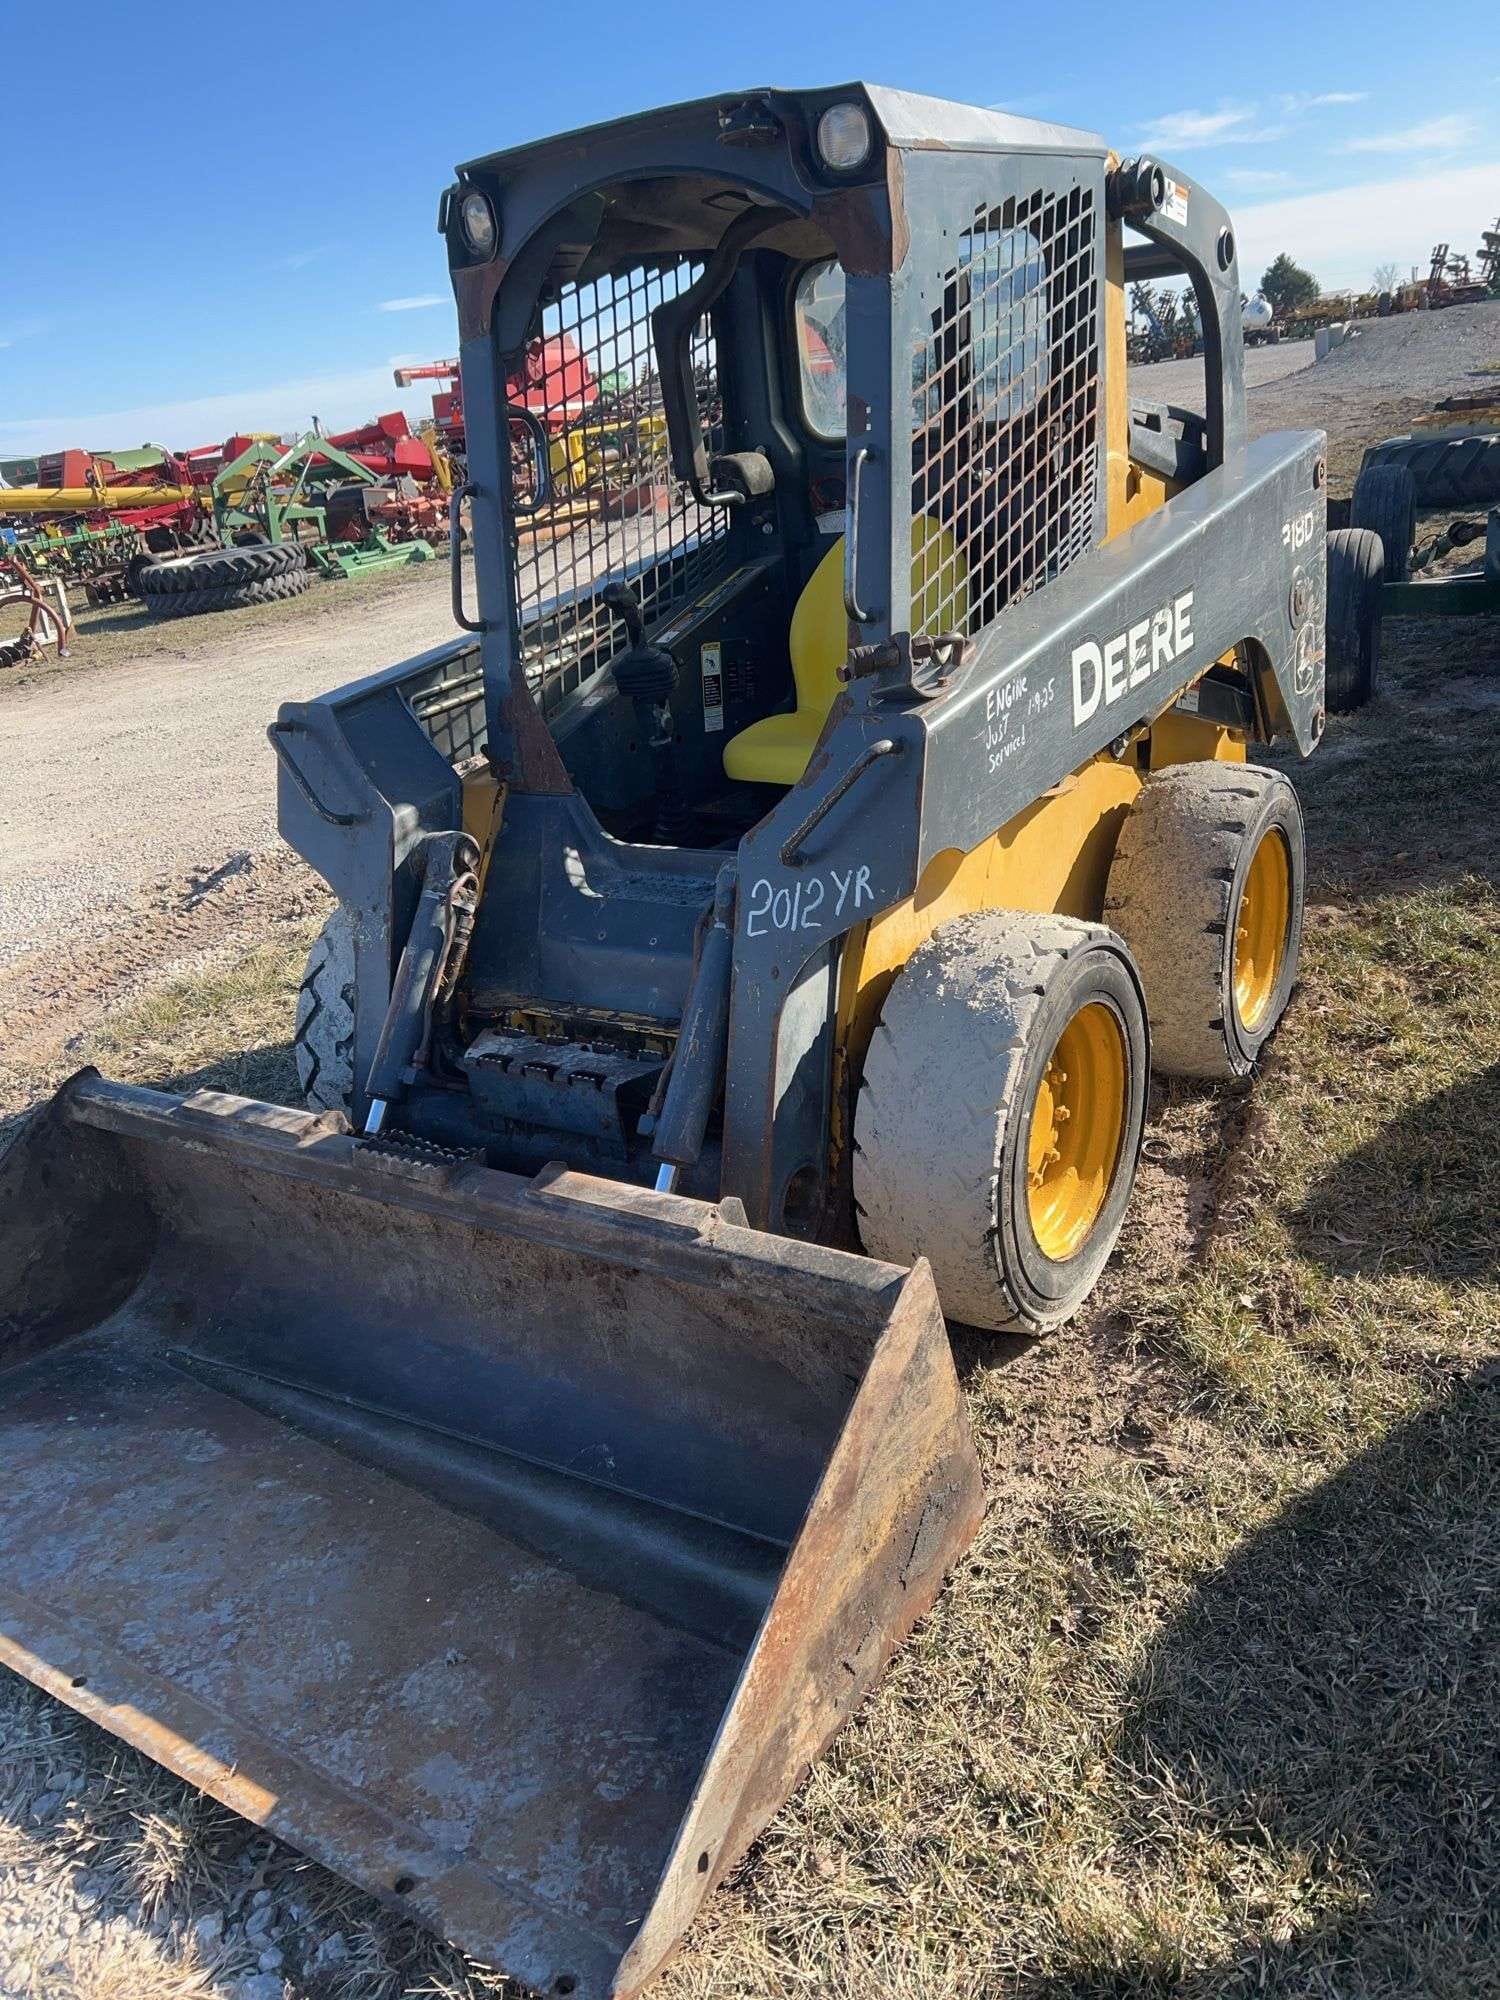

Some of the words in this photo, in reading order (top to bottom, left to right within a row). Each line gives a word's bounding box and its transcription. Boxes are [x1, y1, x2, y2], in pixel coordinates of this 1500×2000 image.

[1071, 591, 1194, 728] DEERE
[747, 878, 825, 937] 2012
[830, 865, 875, 917] YR
